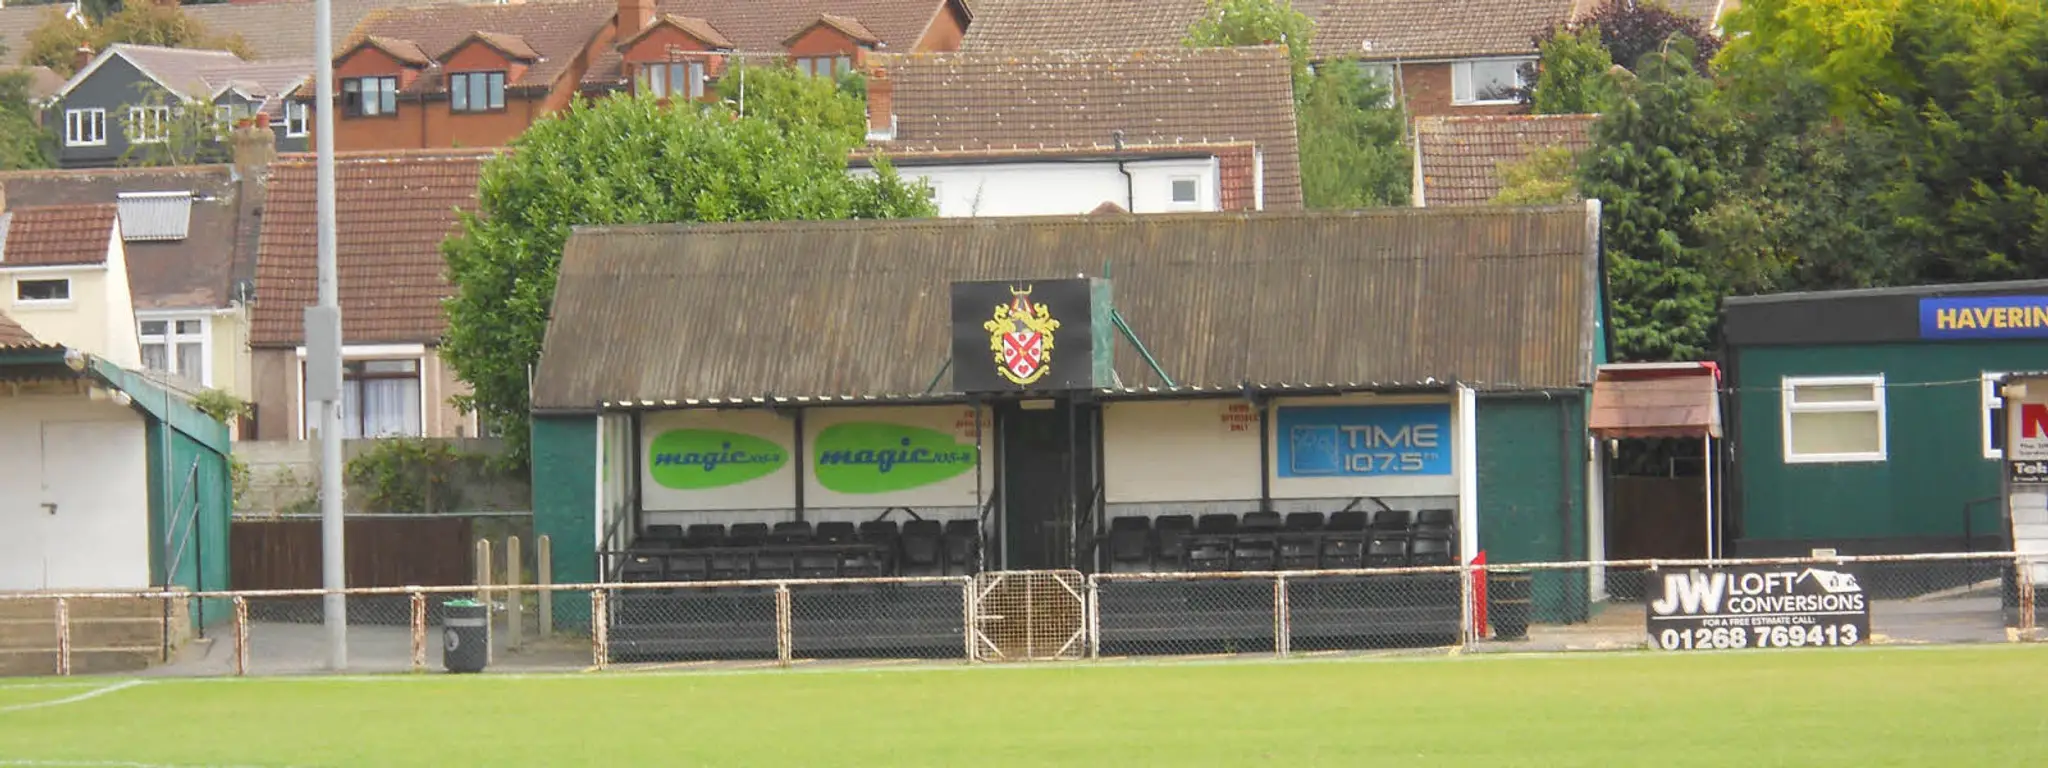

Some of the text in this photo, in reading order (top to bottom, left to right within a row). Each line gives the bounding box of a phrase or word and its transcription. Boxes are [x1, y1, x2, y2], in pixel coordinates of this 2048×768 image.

[1341, 424, 1439, 448] TIME
[655, 440, 750, 472] magic
[820, 436, 932, 473] magic
[1344, 452, 1423, 472] 107.5
[1653, 570, 1798, 614] JW LOFT
[1727, 594, 1865, 613] CONVERSIONS
[1703, 618, 1720, 627] FOR
[1721, 618, 1728, 626] A
[1729, 617, 1750, 626] FREE
[1751, 616, 1791, 626] ESTIMATE
[1660, 623, 1858, 650] 01268 769413
